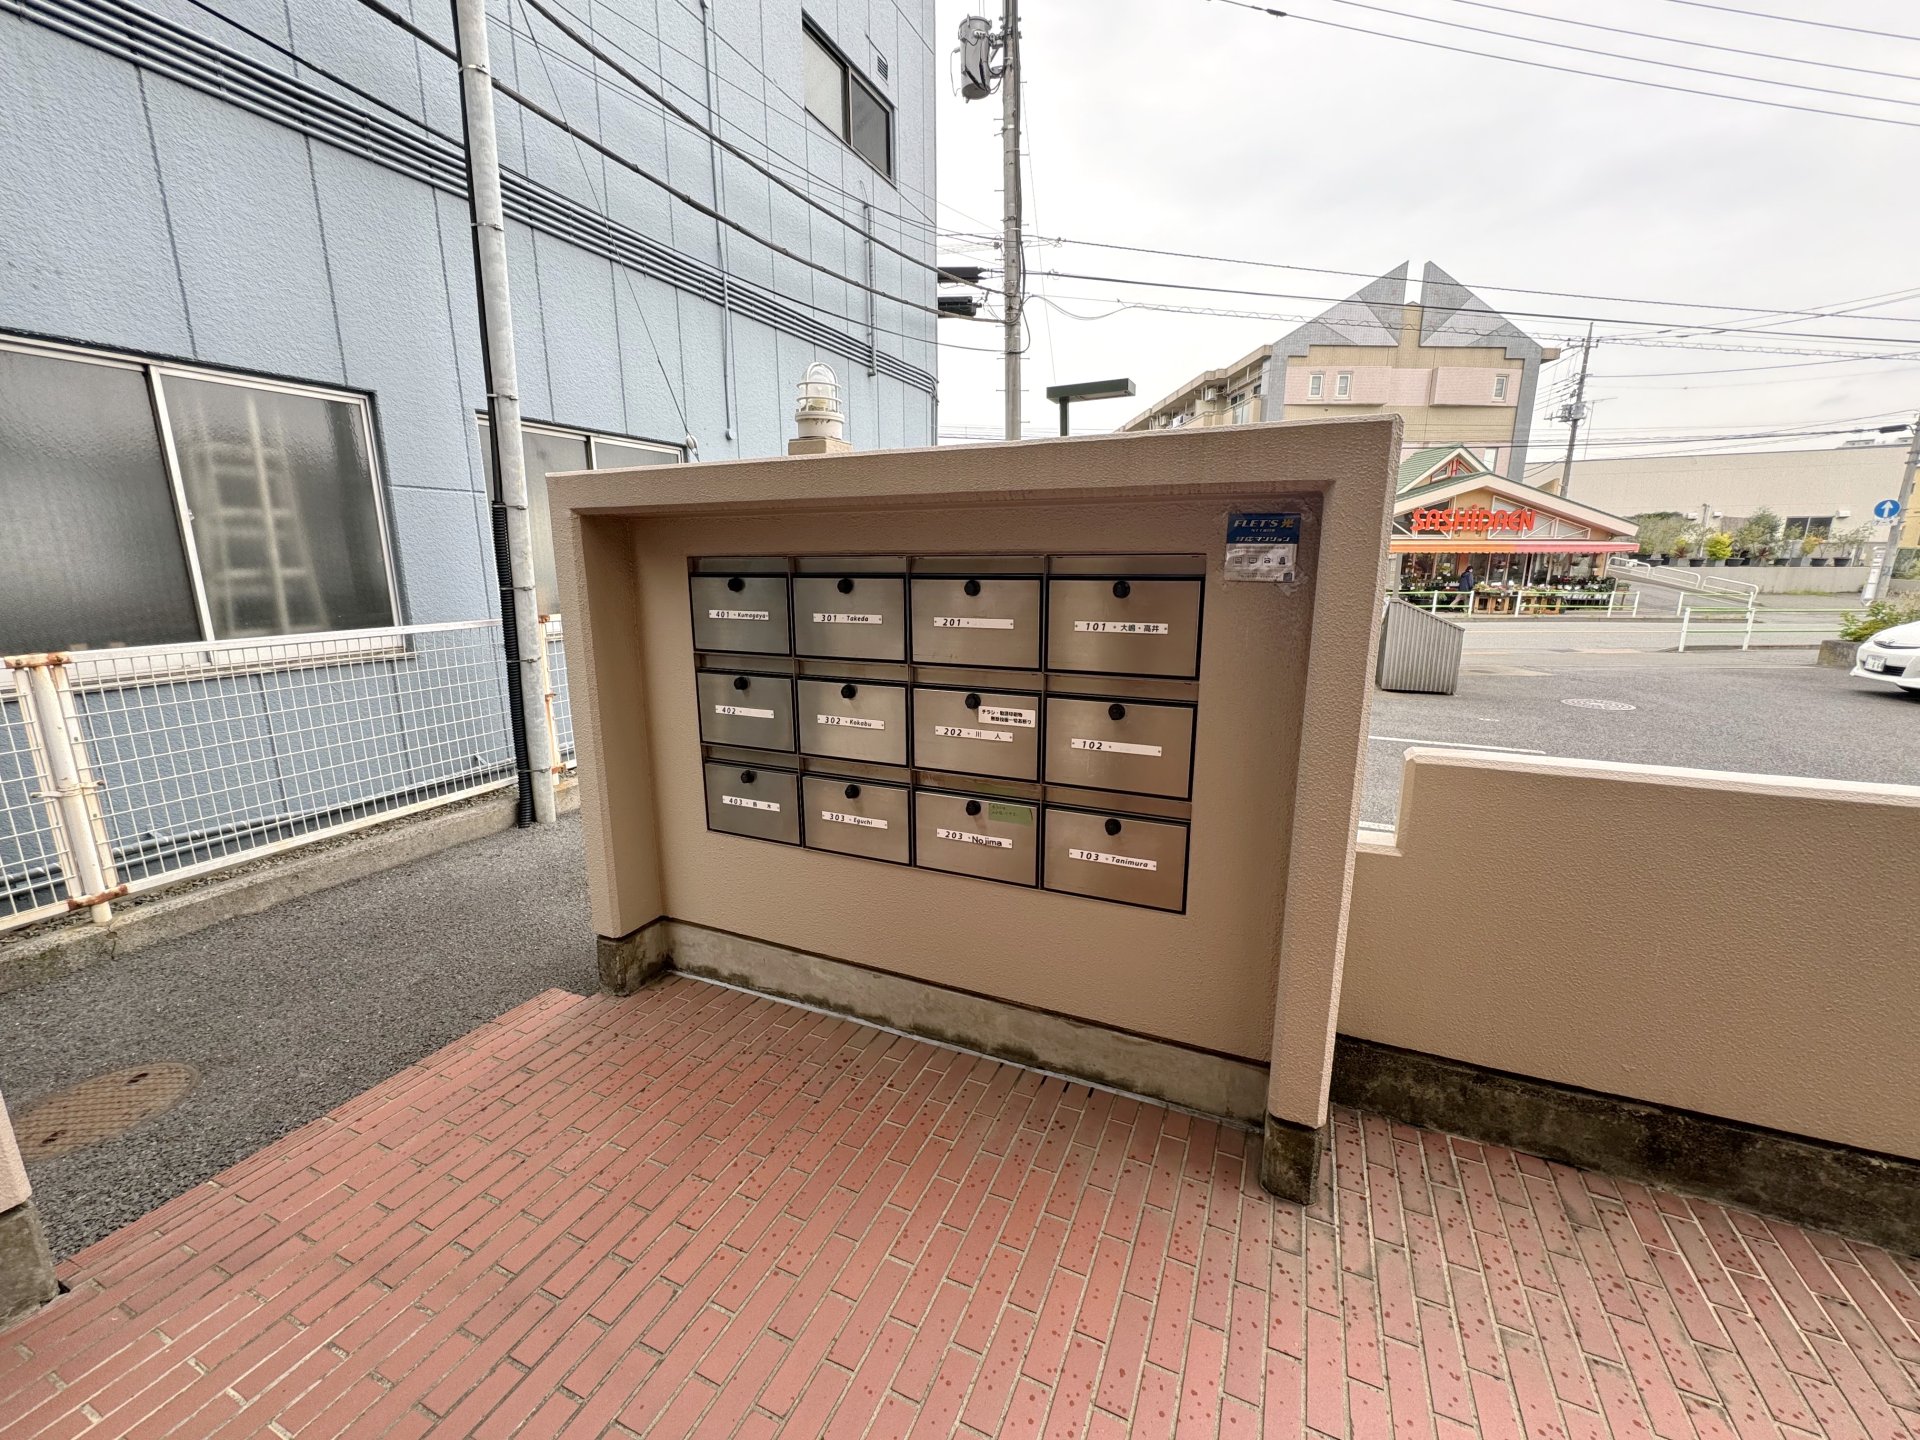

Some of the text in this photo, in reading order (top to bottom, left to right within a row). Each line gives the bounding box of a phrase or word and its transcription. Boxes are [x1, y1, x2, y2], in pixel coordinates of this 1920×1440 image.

[1234, 518, 1294, 528] FLET'S 光
[821, 614, 837, 622] 301
[942, 618, 961, 627] 201
[1085, 622, 1106, 631] 101
[721, 707, 736, 715] 402
[825, 716, 841, 725] 302
[943, 727, 963, 737] 202
[1082, 741, 1103, 750] 102
[728, 797, 743, 806] 403
[829, 813, 873, 825] 303 Eguchi
[945, 830, 1003, 847] 203 Nojima
[1079, 851, 1149, 868] 103 Tanimura
